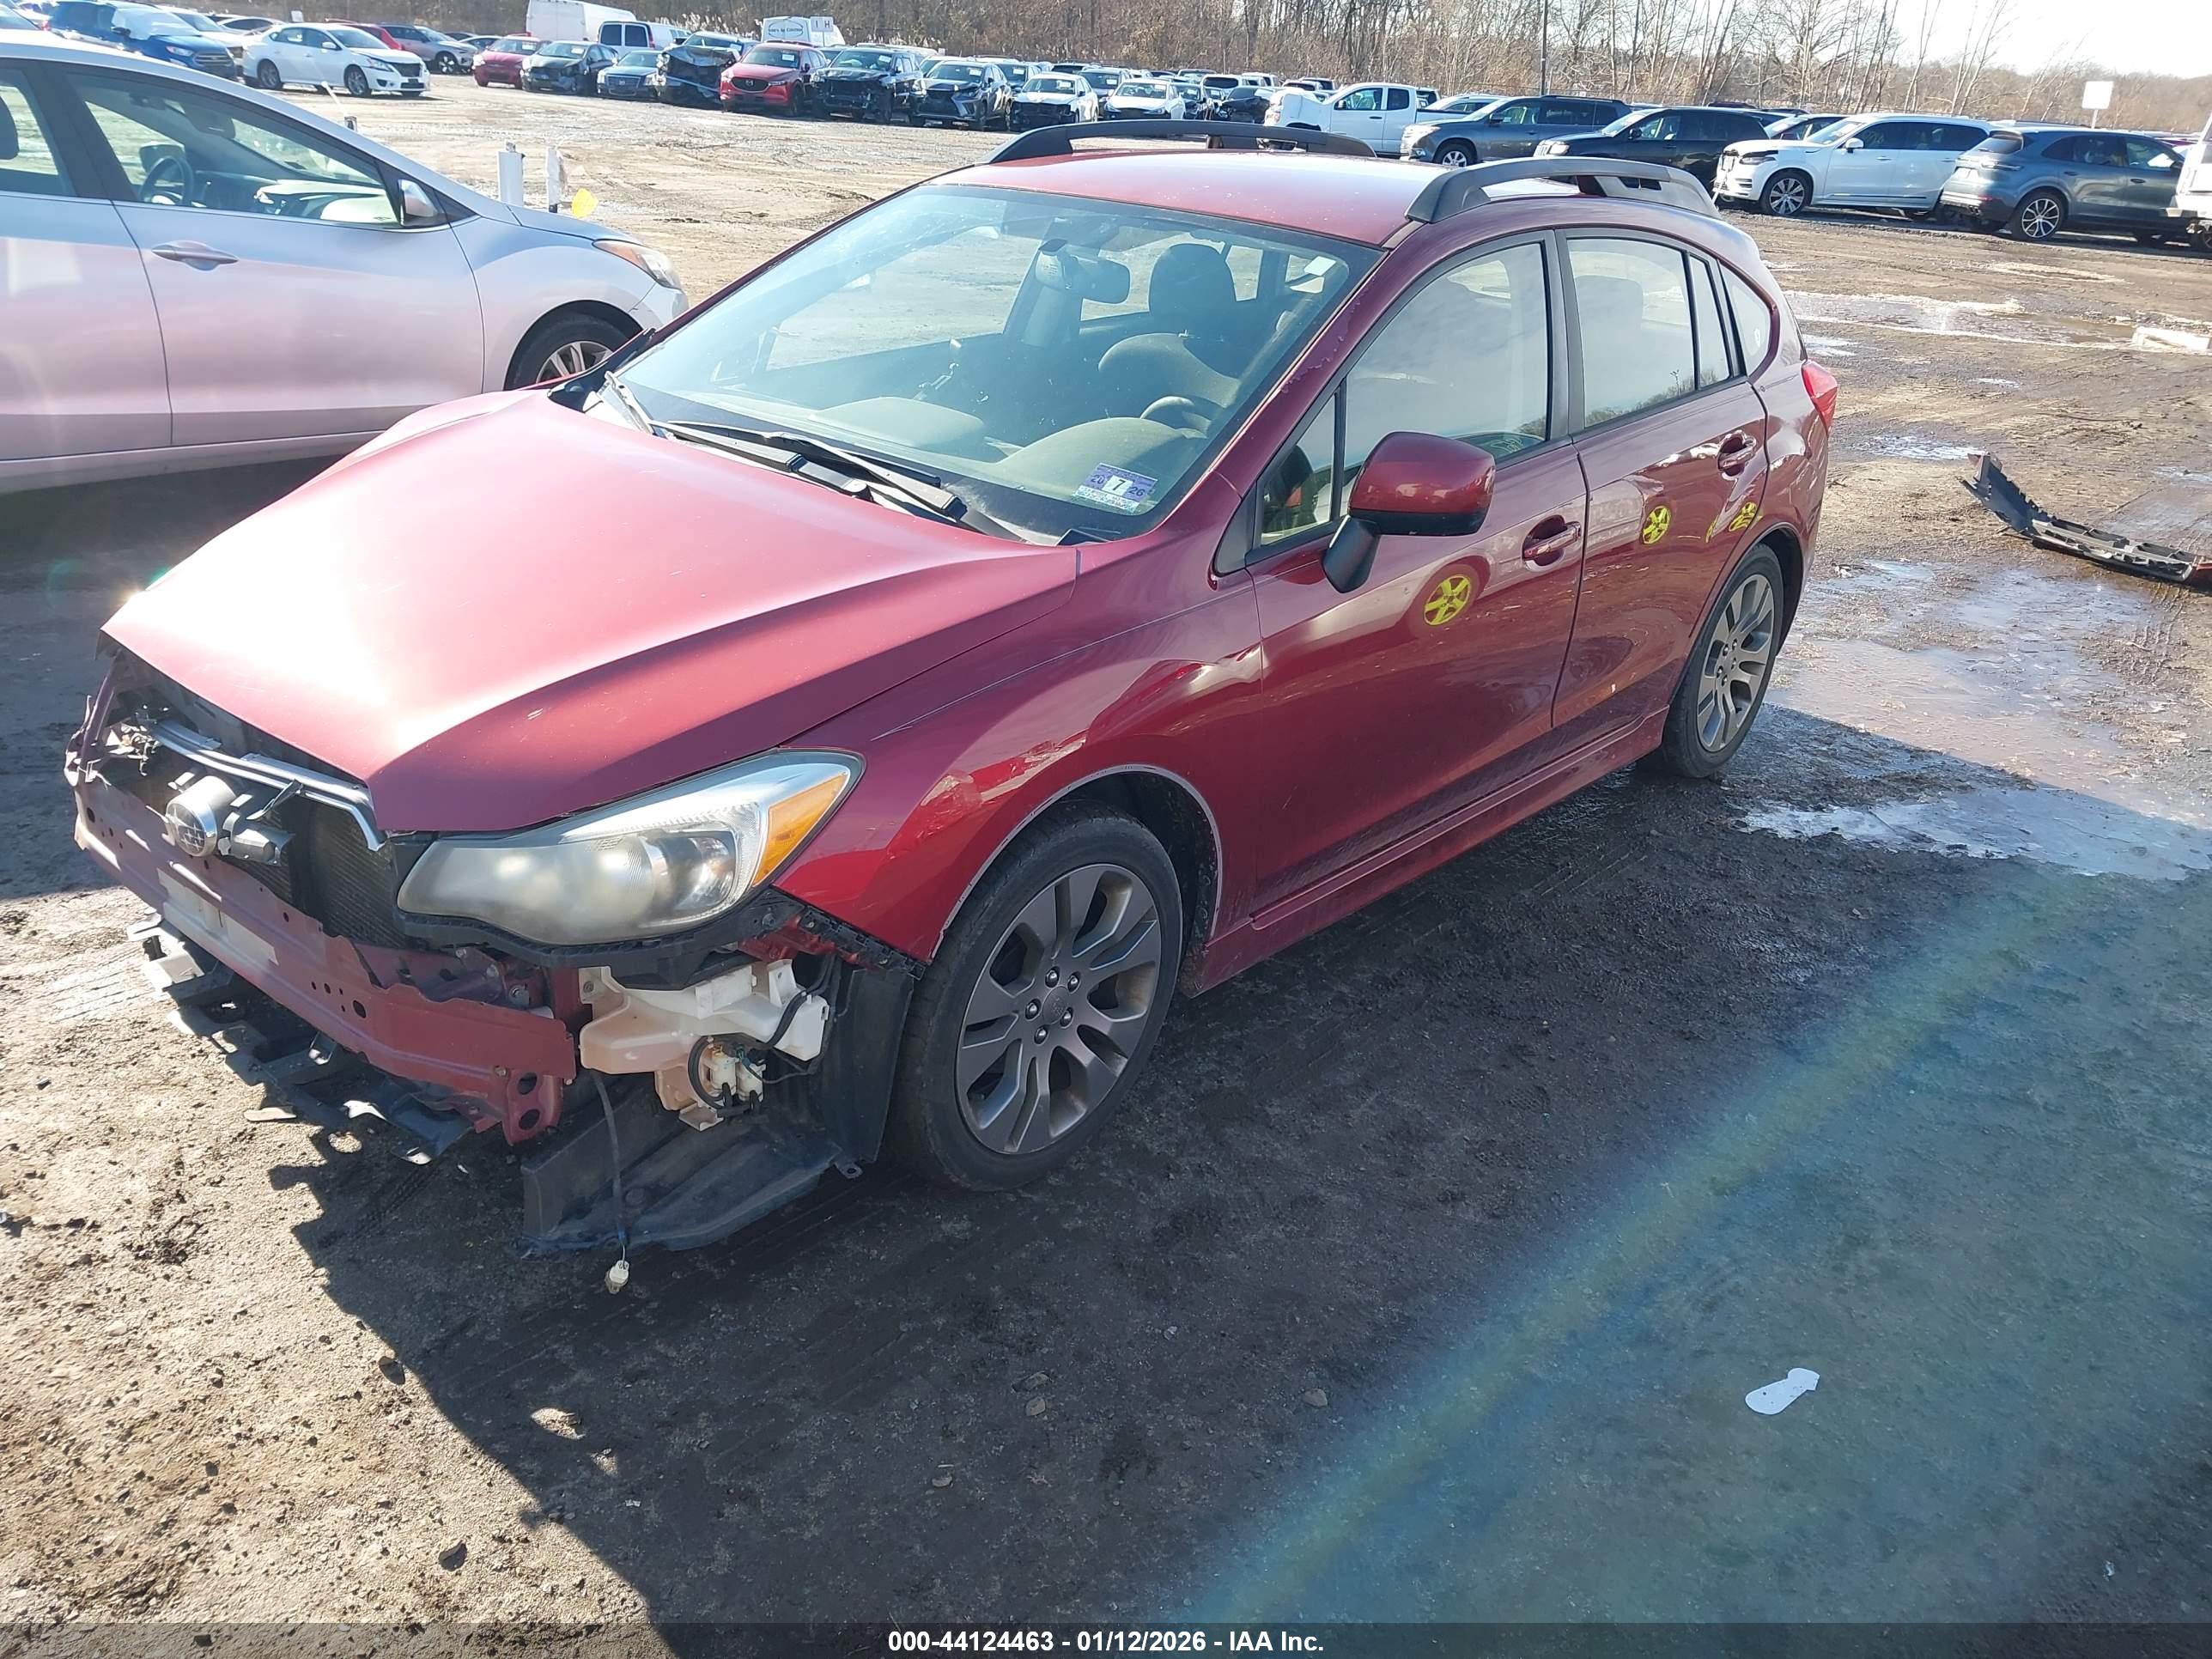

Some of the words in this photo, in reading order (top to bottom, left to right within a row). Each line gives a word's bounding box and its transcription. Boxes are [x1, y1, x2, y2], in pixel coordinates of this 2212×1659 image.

[824, 20, 830, 28] H
[1091, 474, 1106, 484] 20
[1112, 479, 1126, 491] 7
[1128, 486, 1146, 496] 26
